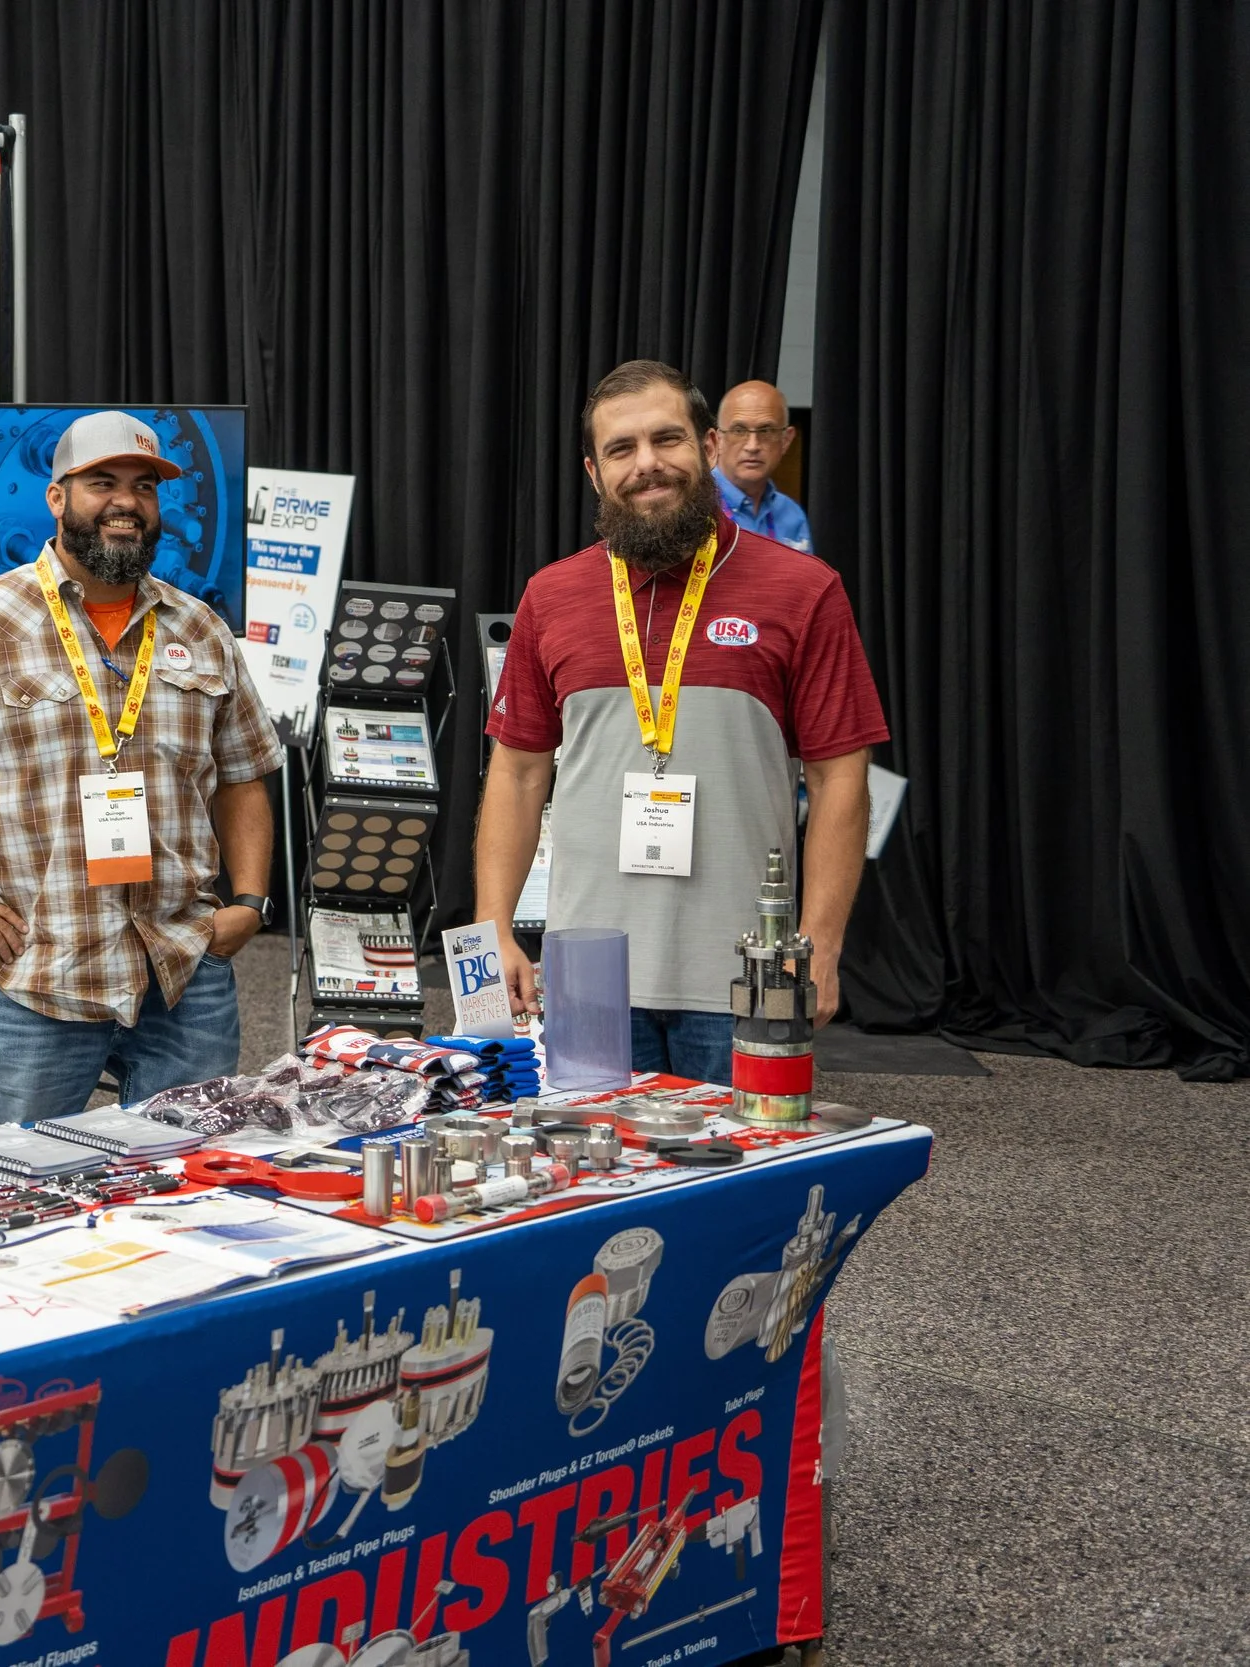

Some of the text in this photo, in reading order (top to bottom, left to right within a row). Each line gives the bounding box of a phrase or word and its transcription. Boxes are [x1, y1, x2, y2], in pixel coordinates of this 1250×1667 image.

[273, 497, 331, 517] PRIME
[270, 513, 318, 532] EXPO
[251, 540, 314, 559] This way to the
[277, 558, 303, 572] Lunch
[295, 579, 307, 595] by
[715, 622, 749, 638] USA
[168, 649, 186, 658] USA
[463, 935, 482, 945] PRIME
[464, 944, 479, 953] EXPO
[455, 952, 500, 996] BIC
[460, 989, 505, 1012] MARKETING
[463, 1004, 508, 1026] PARTNER
[724, 1385, 765, 1414] Tube Plugs
[488, 1477, 537, 1505] Shoulder
[538, 1465, 567, 1485] Plugs
[568, 1459, 577, 1475] &
[580, 1453, 593, 1469] EZ
[637, 1425, 675, 1448] Gaskets
[164, 1408, 763, 1667] INDUSTRIES
[238, 1524, 416, 1603] Isolation & Testing Pipe Plugs
[45, 1641, 99, 1667] Flanges
[674, 1648, 682, 1660] &
[683, 1636, 717, 1656] Tooling
